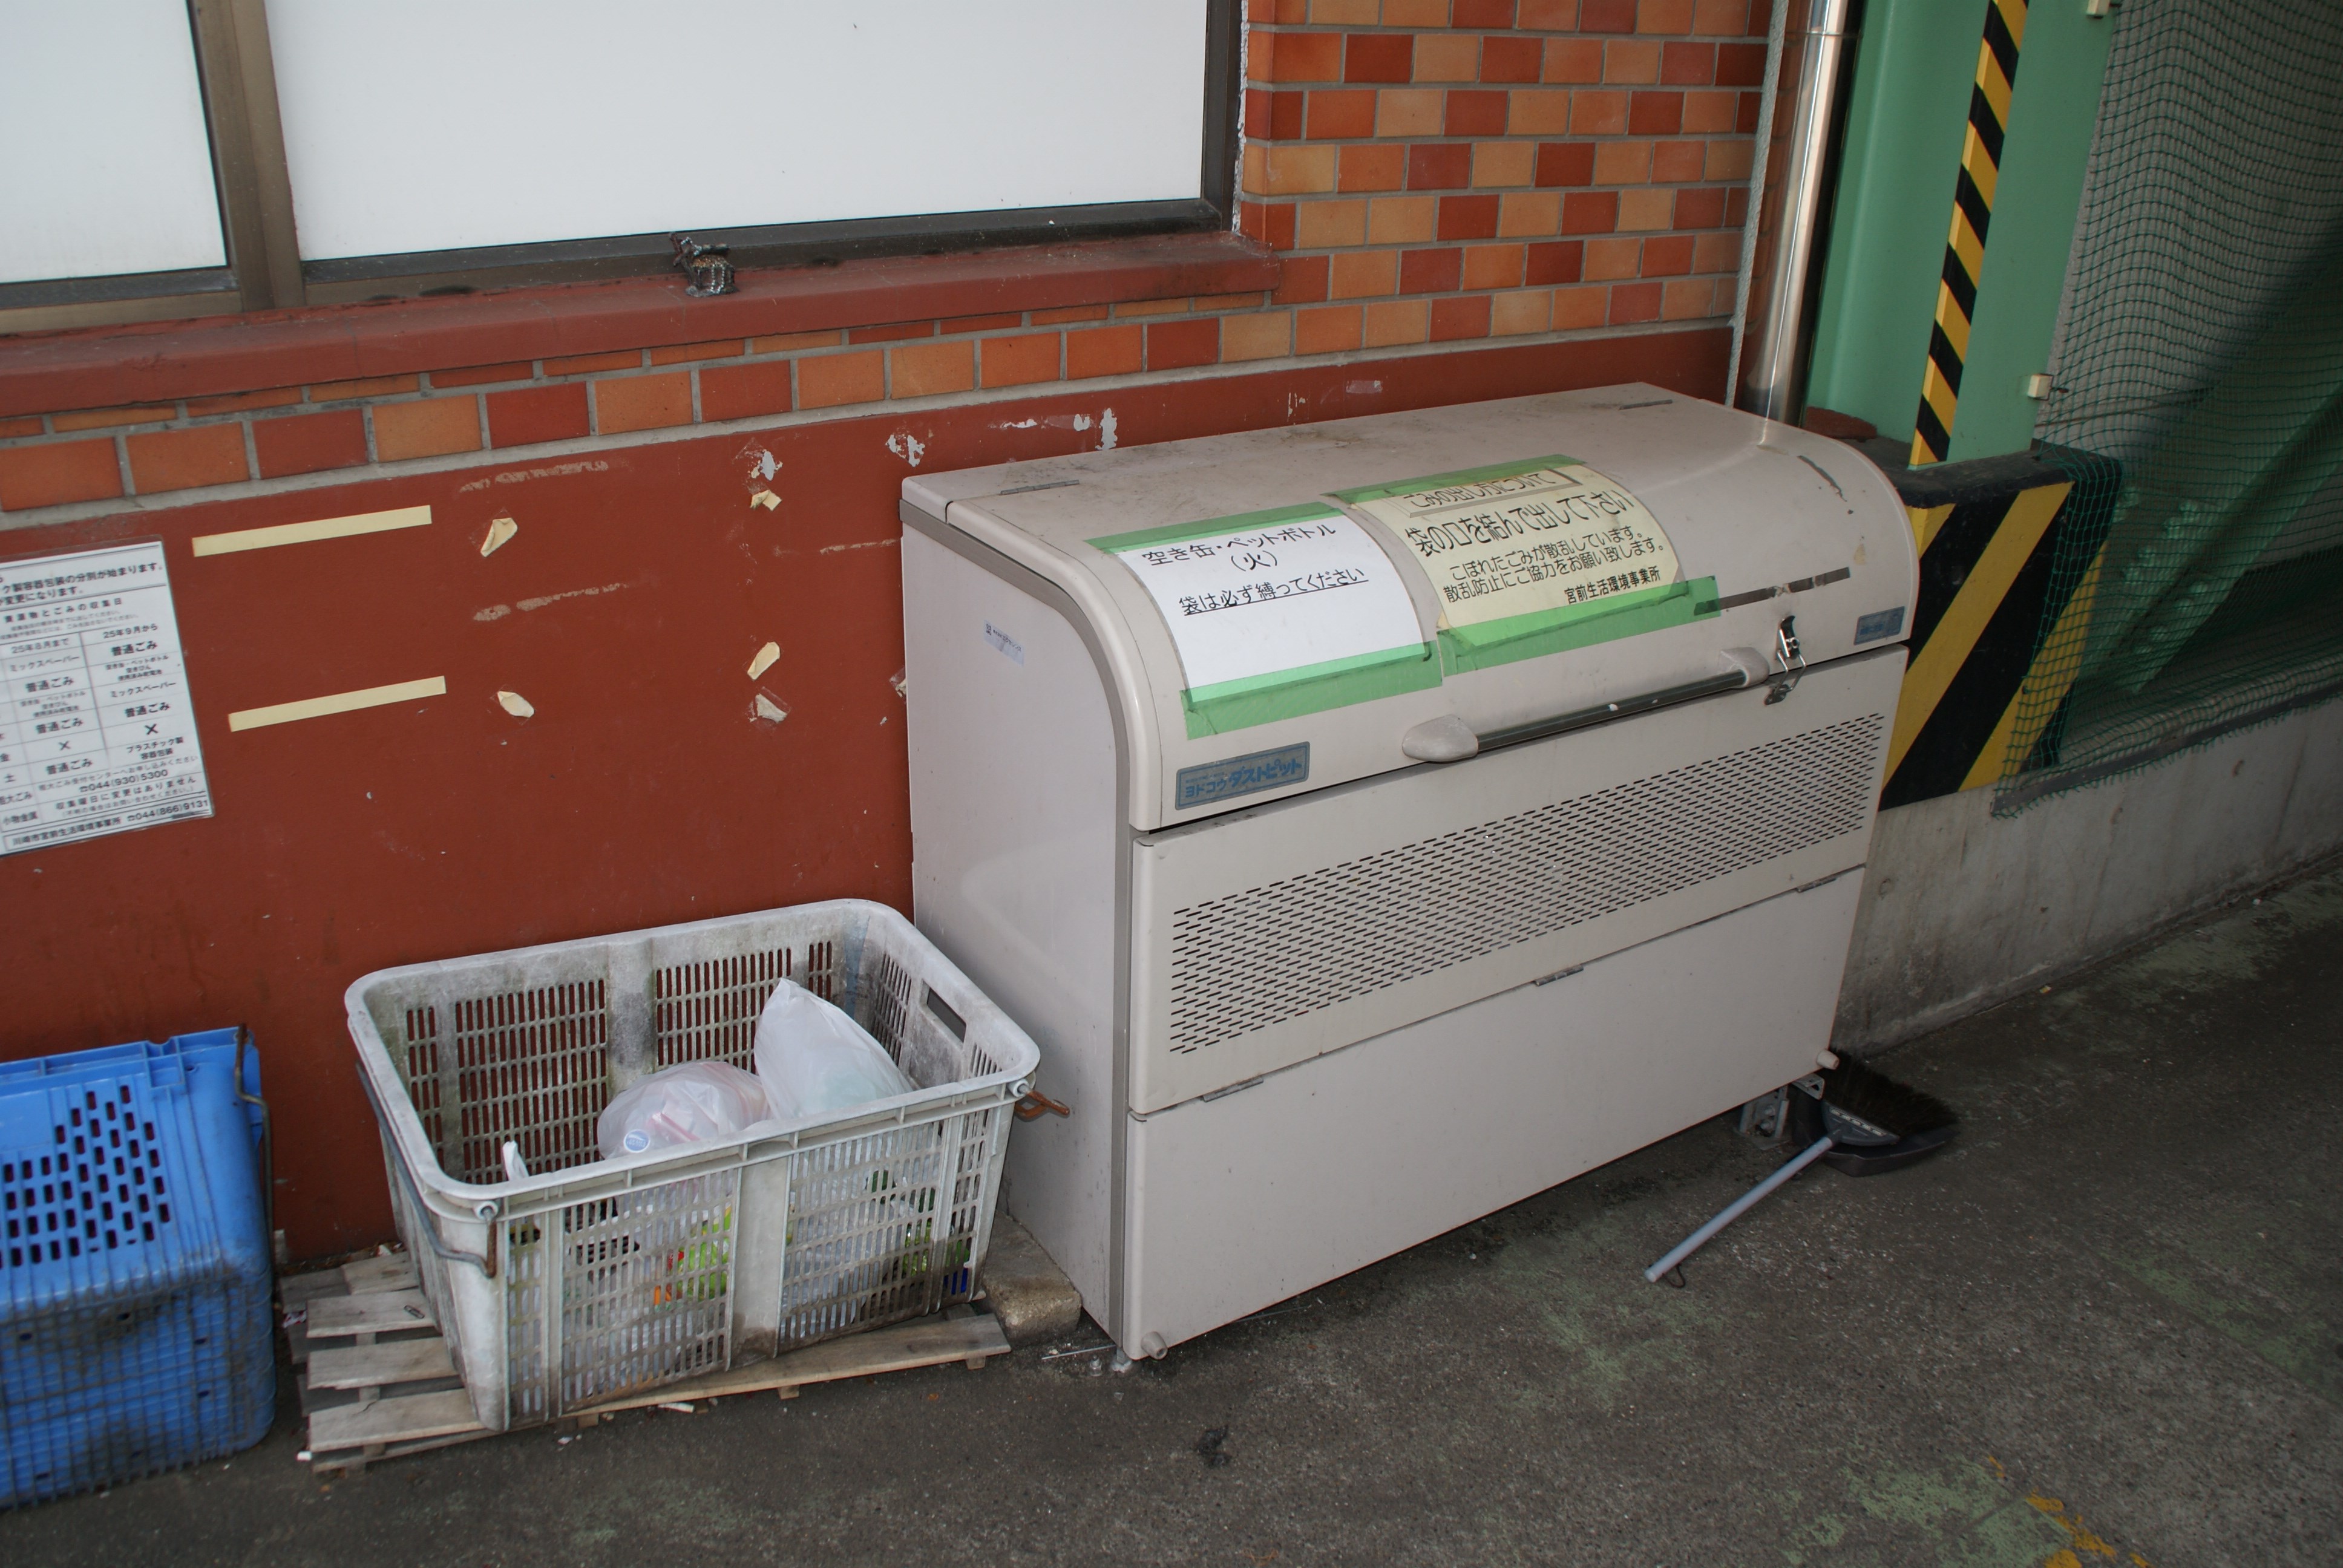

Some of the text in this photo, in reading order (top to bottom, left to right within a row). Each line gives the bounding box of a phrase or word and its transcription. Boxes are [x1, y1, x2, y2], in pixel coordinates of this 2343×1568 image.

[1404, 489, 1635, 557] 袋の口を結んで出して下さい
[1142, 524, 1336, 566] 空き缶・ペットボトル
[1449, 524, 1642, 581] こぼれたごみが散乱しています。
[1443, 536, 1663, 603] 散乱防止にご協力をお願い致します。
[1564, 565, 1661, 604] 宮前生活環境事業所
[1179, 568, 1365, 615] 袋は必ず縛ってください
[111, 640, 158, 656] 普通ごみ
[25, 676, 74, 693] 普通ごみ
[36, 717, 83, 734] 普通ごみ
[125, 702, 171, 718] 普通ごみ
